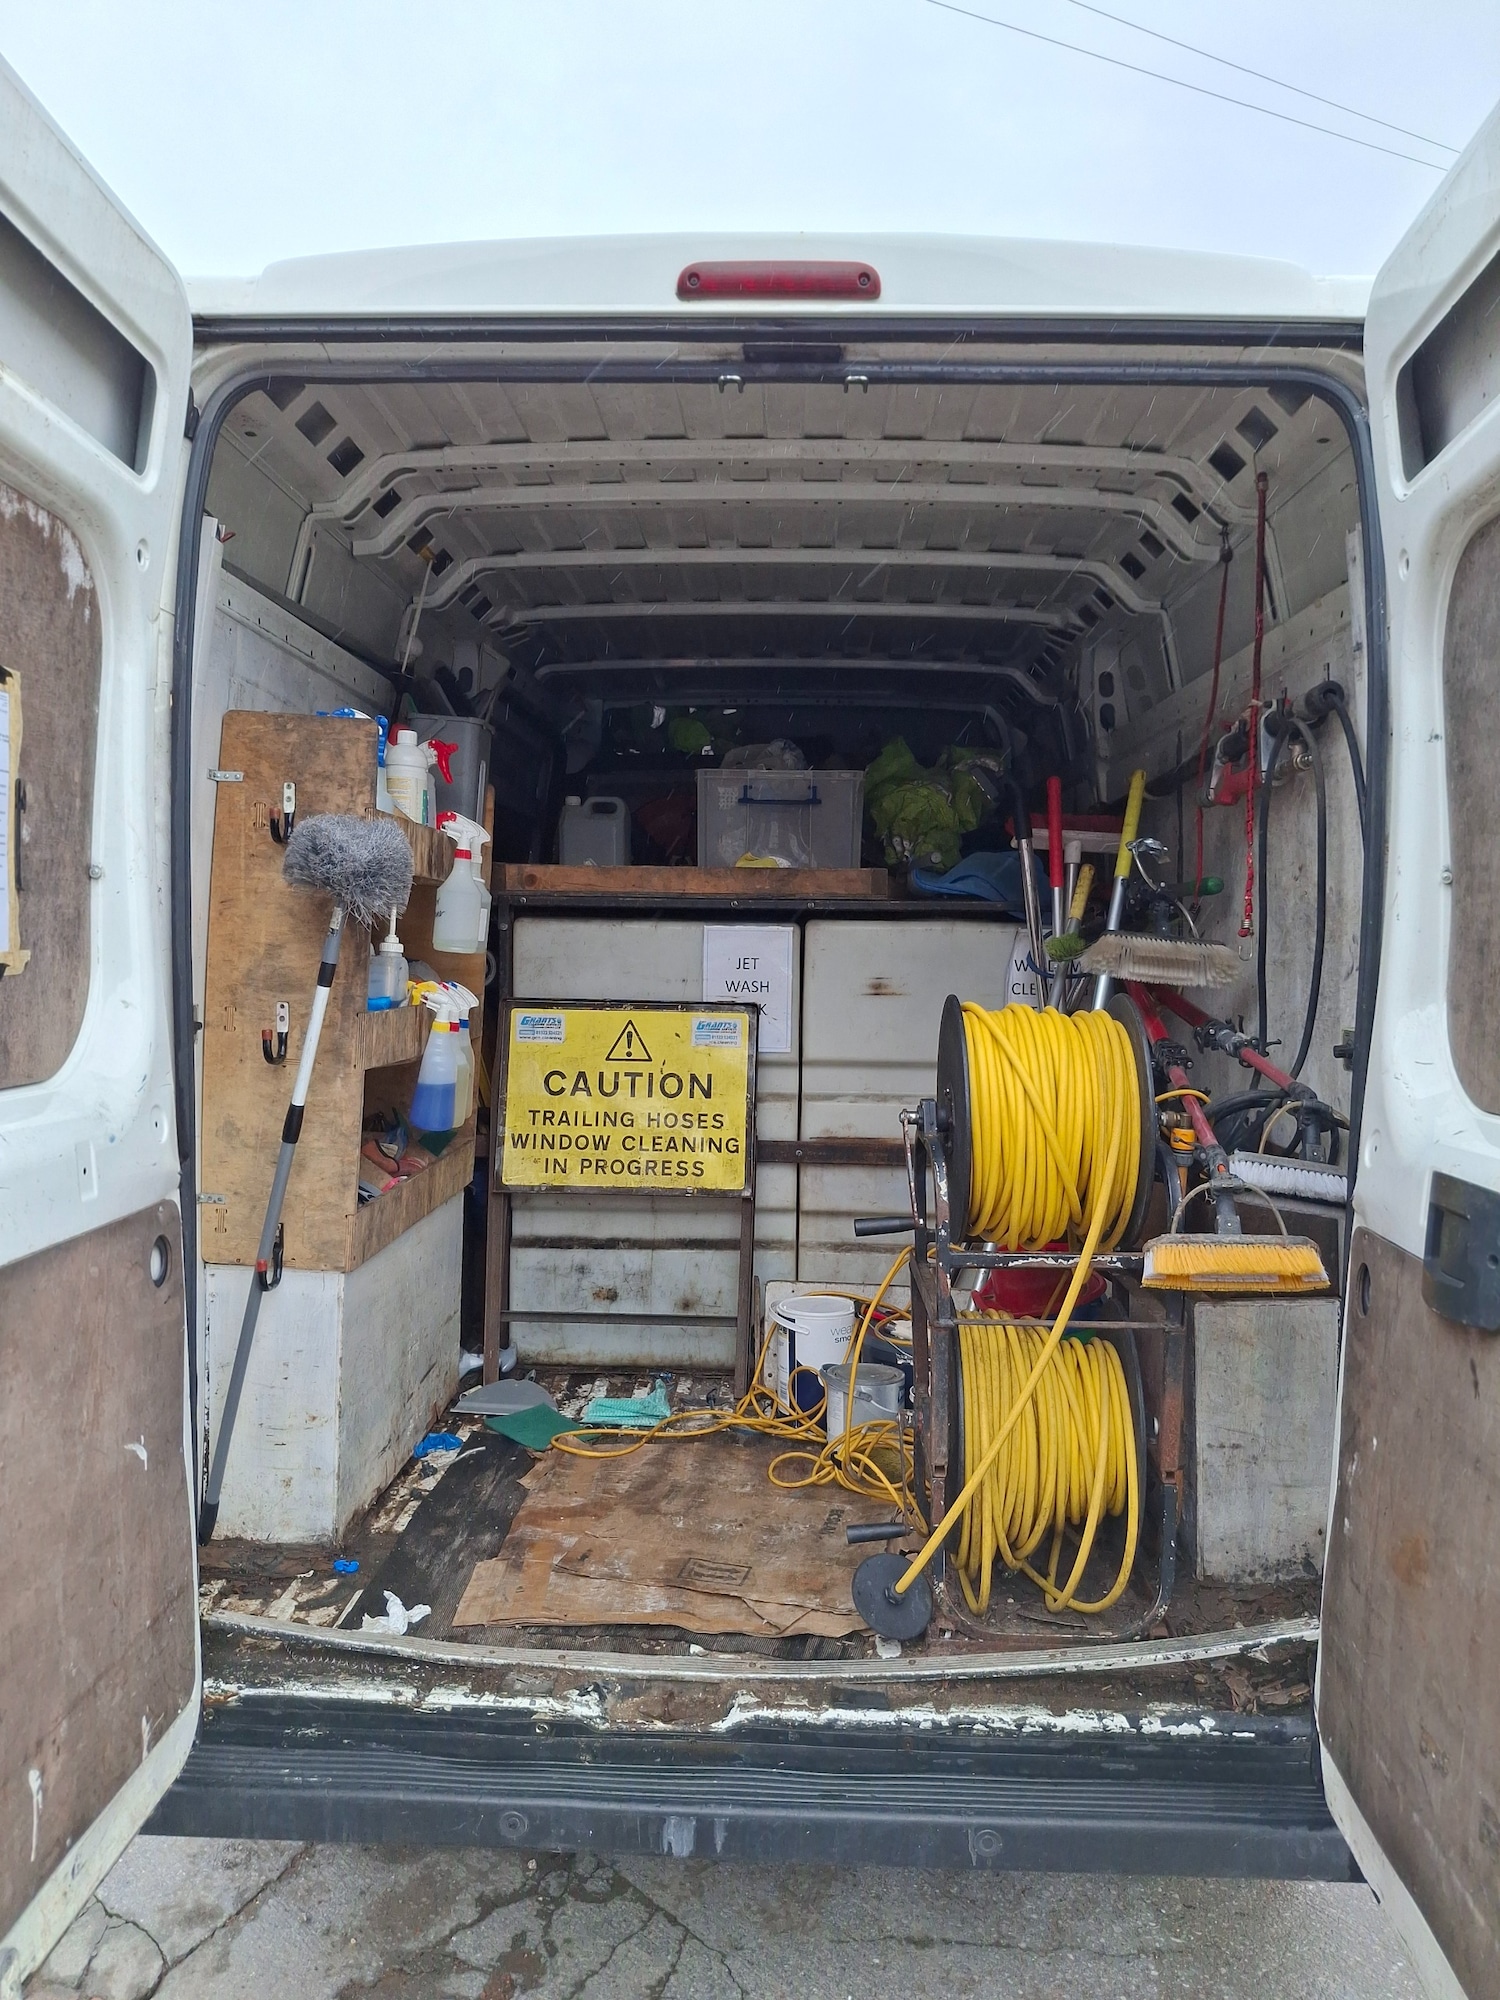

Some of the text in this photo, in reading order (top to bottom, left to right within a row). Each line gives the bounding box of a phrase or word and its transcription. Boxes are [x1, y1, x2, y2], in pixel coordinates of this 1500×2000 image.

[736, 957, 760, 970] JET
[725, 980, 770, 993] WASH
[543, 1070, 713, 1099] CAUTION
[528, 1110, 724, 1129] TRAILING HOSES
[511, 1133, 740, 1154] WINDOW CLEANING
[544, 1157, 705, 1177] IN PROGRESS
[830, 1324, 853, 1336] wea
[834, 1335, 852, 1344] smo
